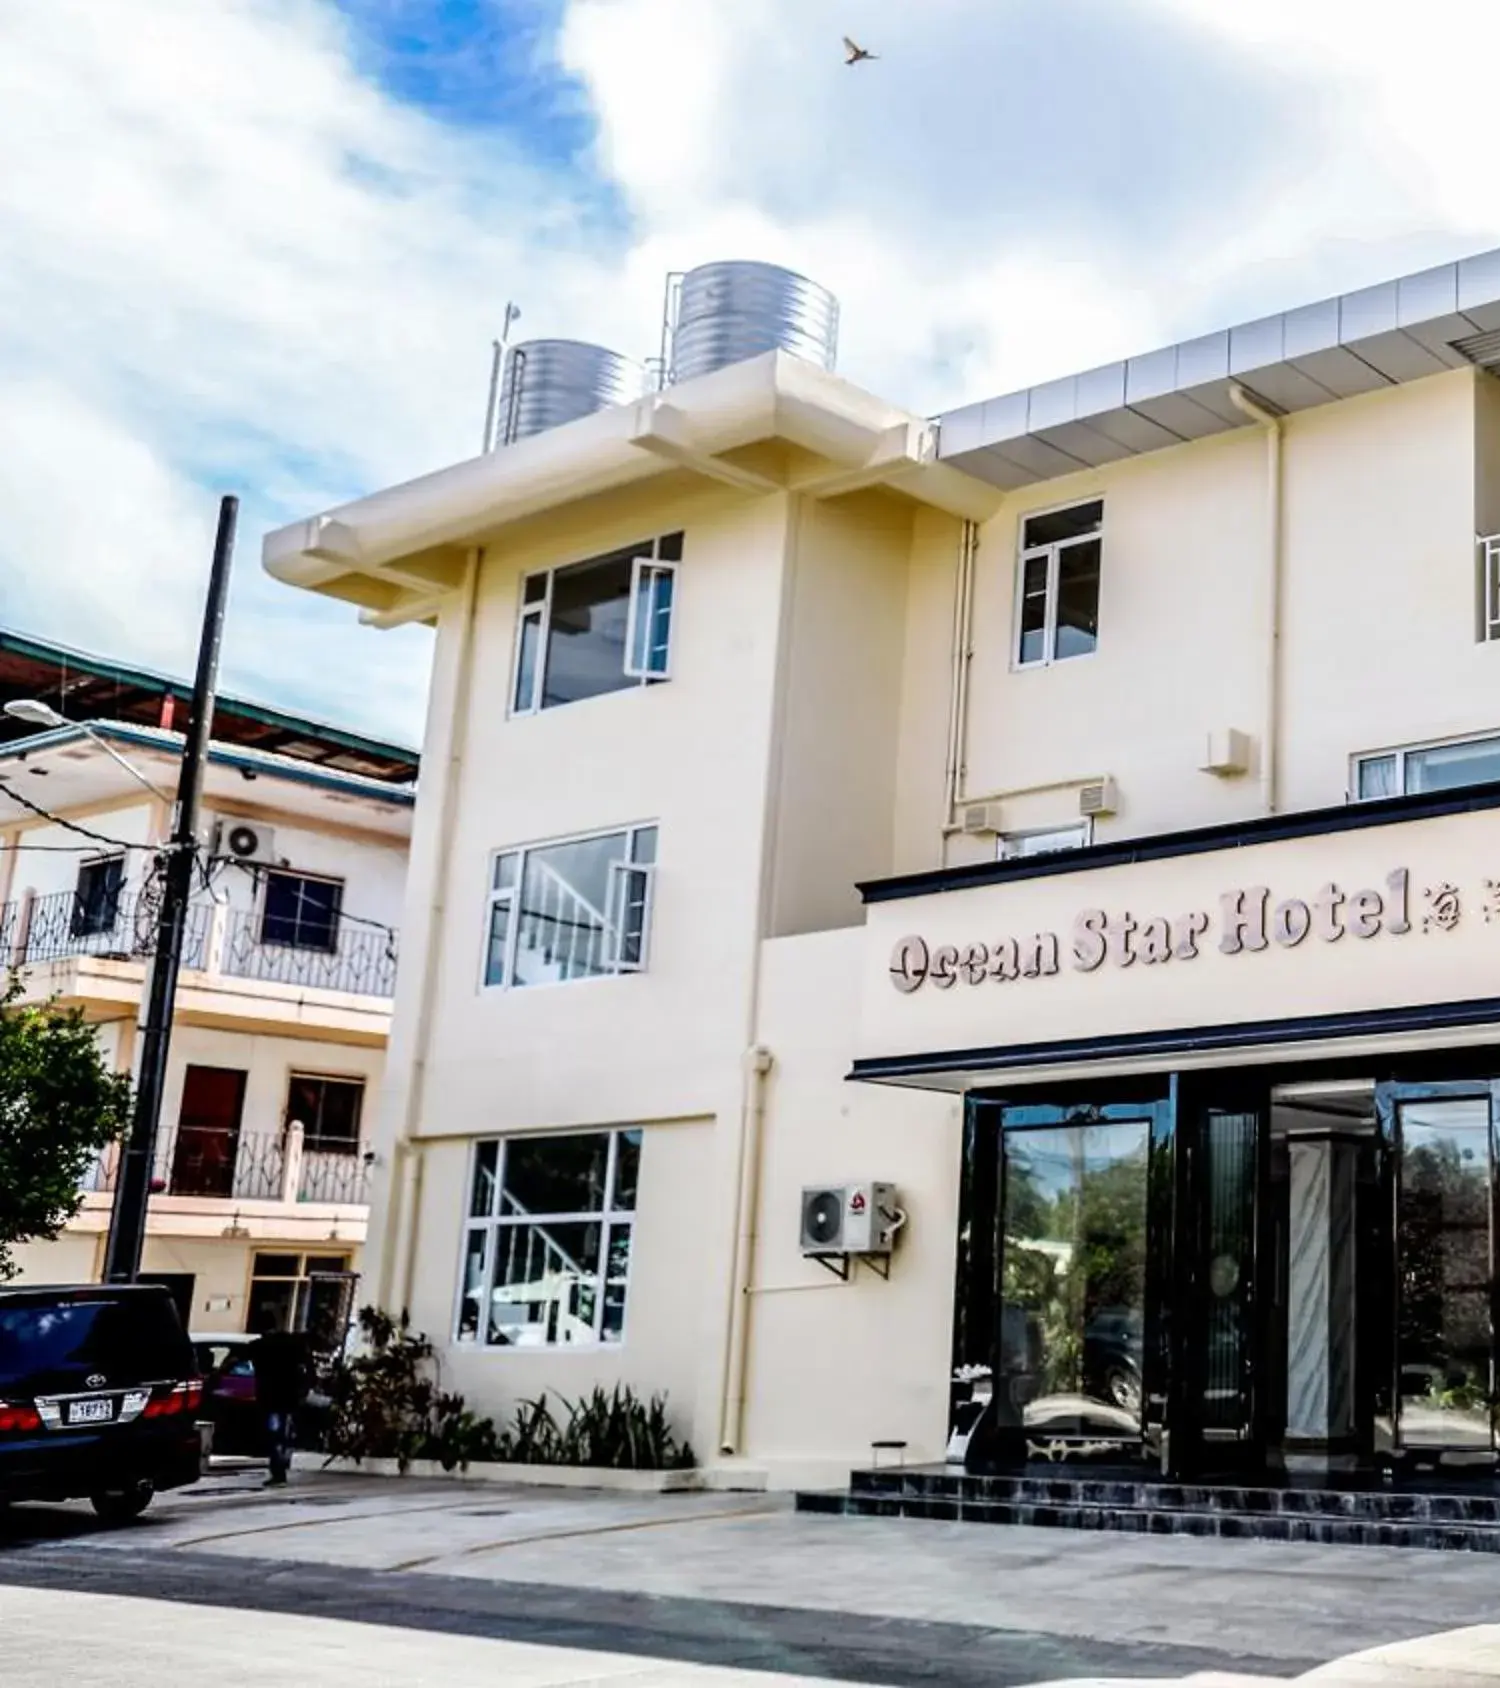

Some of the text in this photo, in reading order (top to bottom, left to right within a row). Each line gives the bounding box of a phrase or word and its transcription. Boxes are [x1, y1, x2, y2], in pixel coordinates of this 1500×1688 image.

[889, 867, 1413, 994] Ocean Star Hotel
